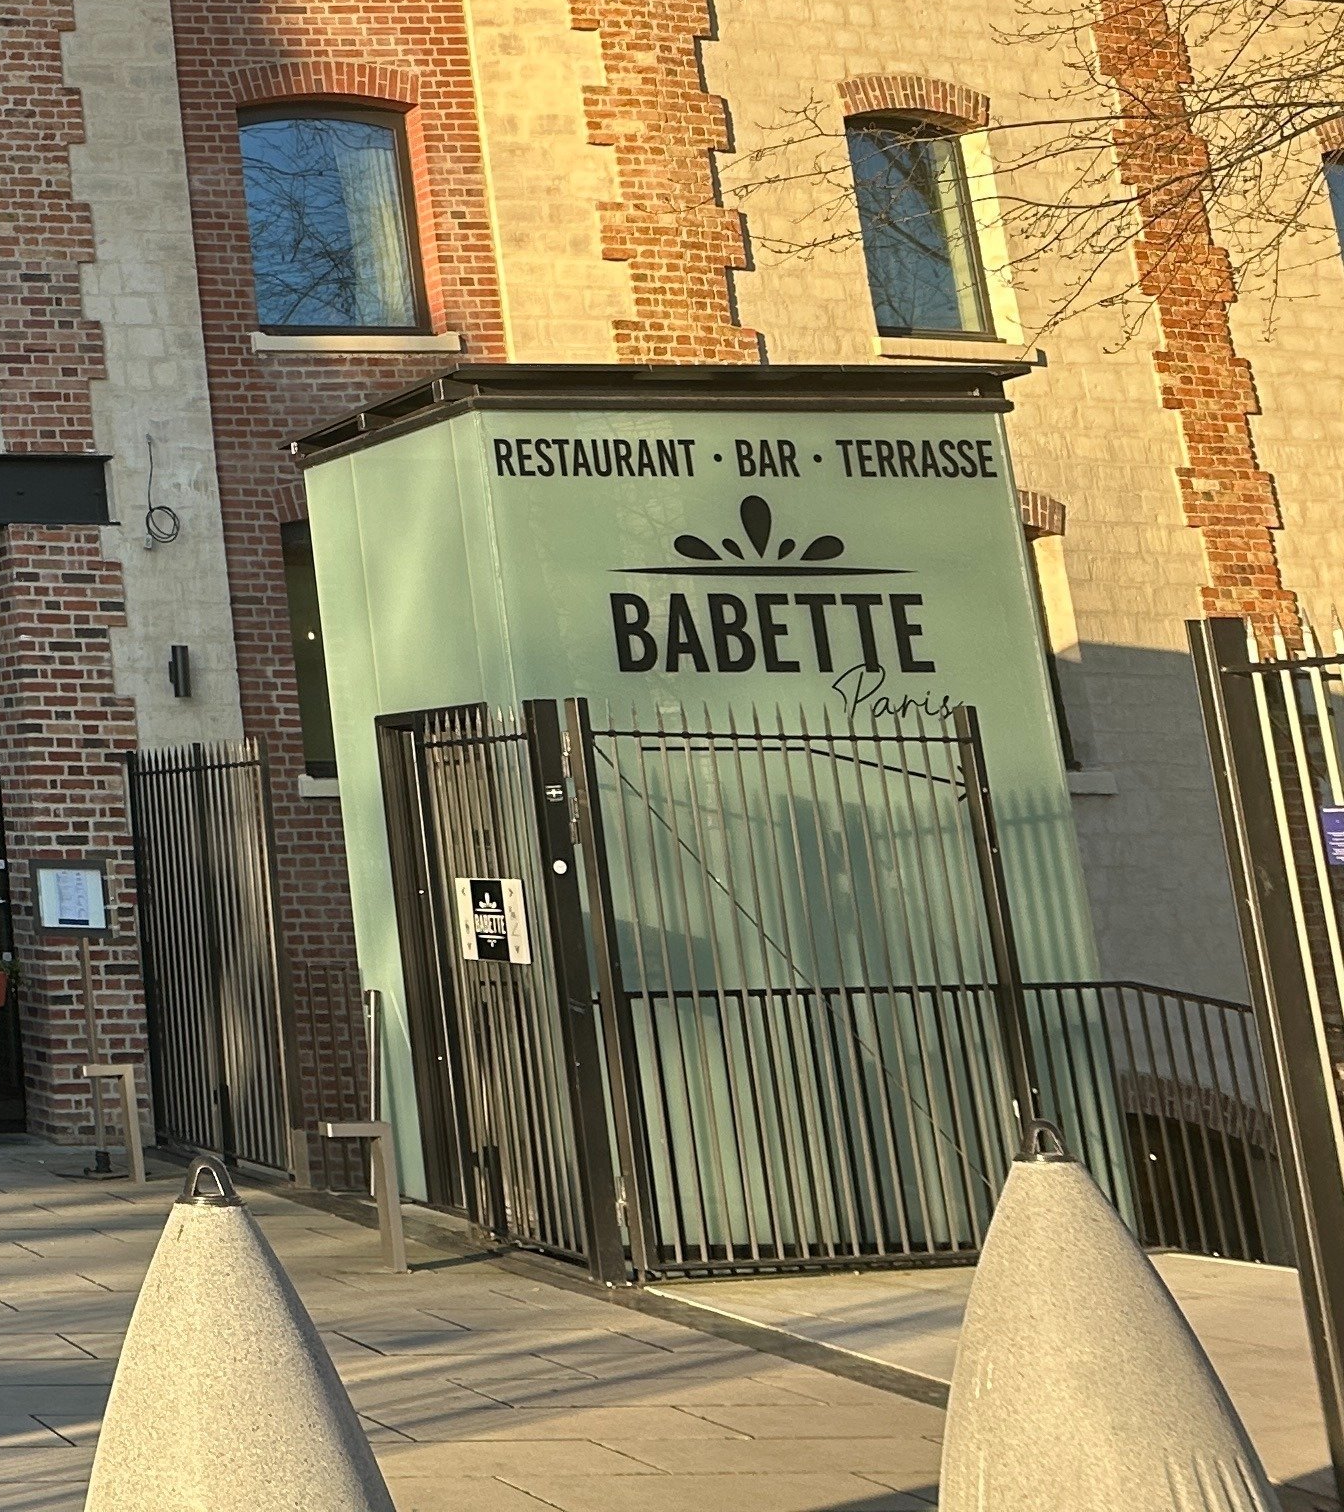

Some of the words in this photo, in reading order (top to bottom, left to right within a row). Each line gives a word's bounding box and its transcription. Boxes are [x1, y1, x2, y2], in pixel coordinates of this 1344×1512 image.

[493, 438, 696, 477] RESTAURANT
[734, 439, 801, 478] BAR
[835, 439, 998, 479] TERRASSE
[609, 592, 937, 673] BABETTE
[831, 663, 964, 721] Paris
